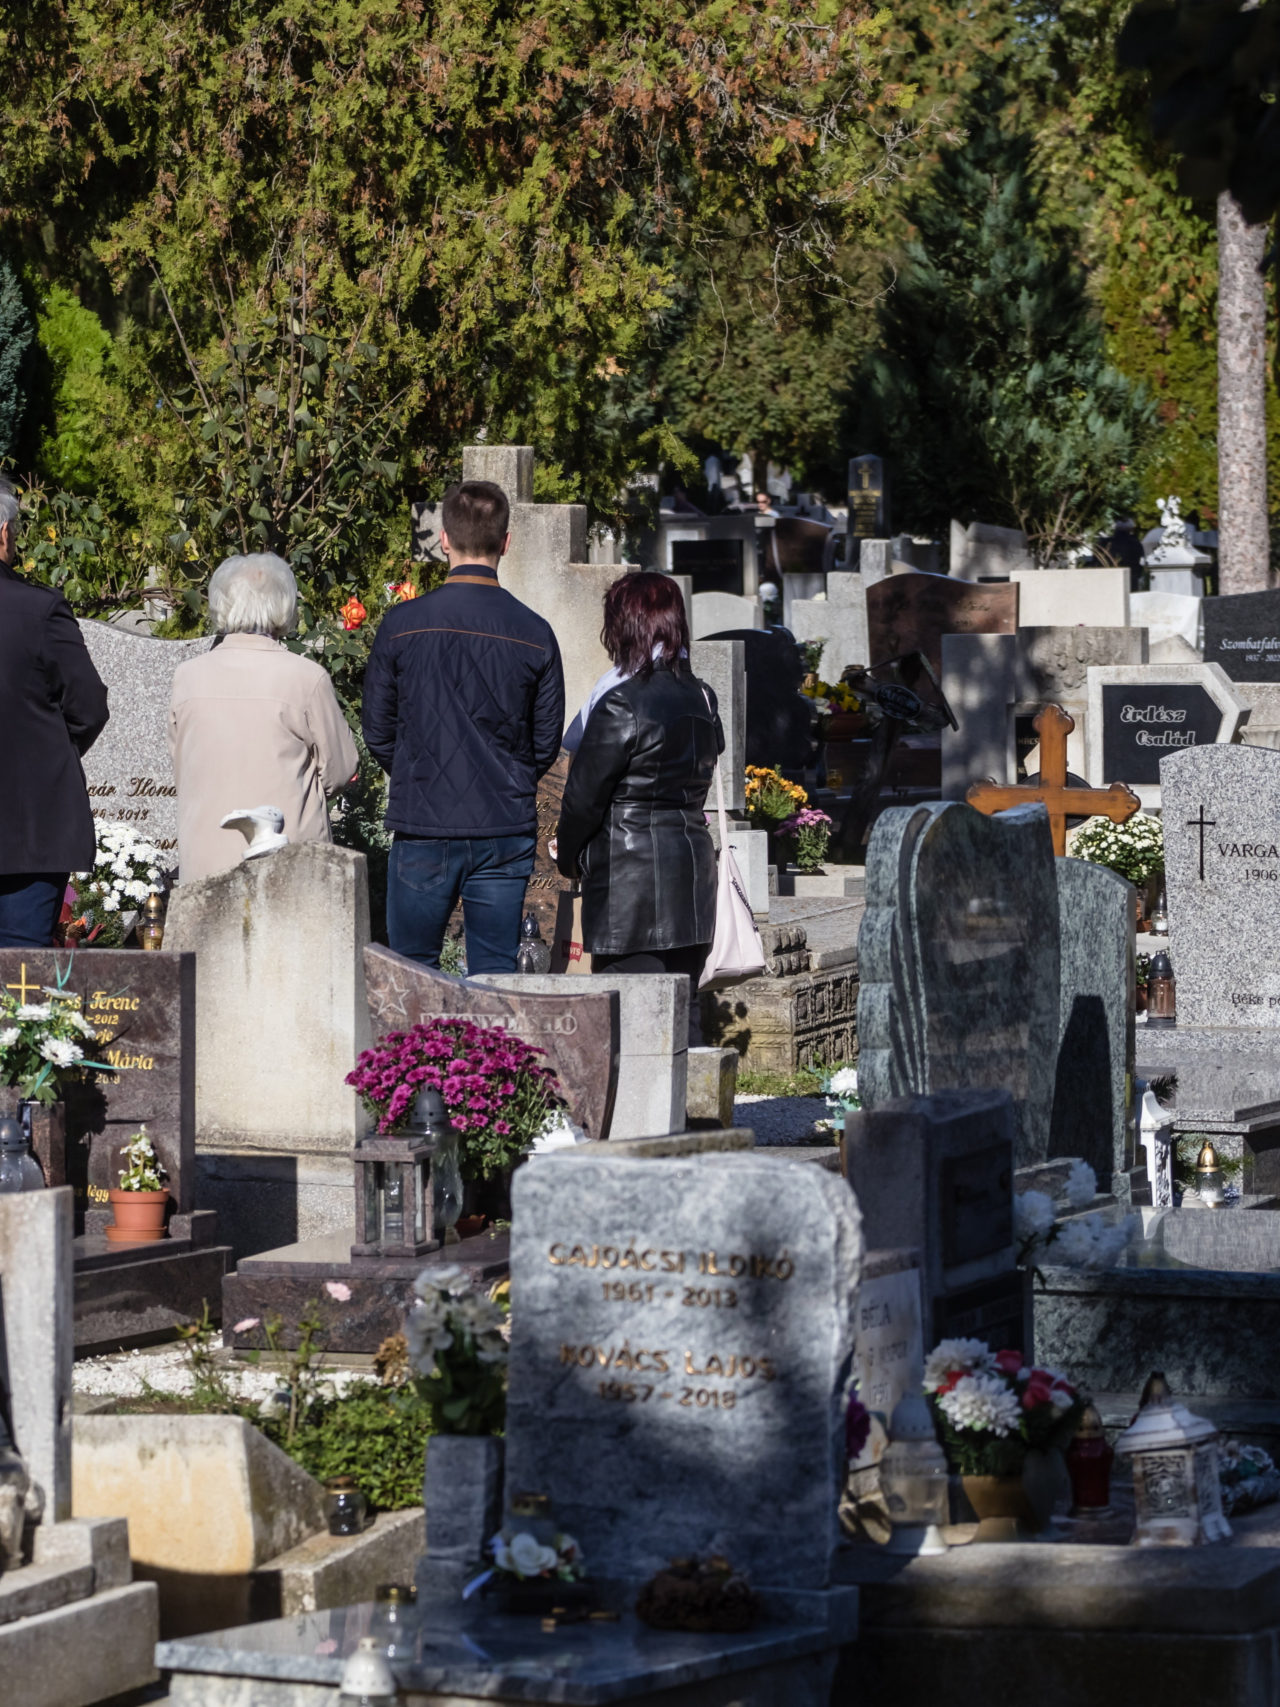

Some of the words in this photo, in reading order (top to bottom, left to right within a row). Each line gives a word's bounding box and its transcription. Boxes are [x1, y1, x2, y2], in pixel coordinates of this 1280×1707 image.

[1120, 704, 1187, 723] Erdész
[1135, 730, 1196, 746] Család
[1218, 843, 1280, 858] VARGA
[89, 991, 140, 1011] Ferenc
[106, 1050, 154, 1070] Mária
[699, 1250, 795, 1281] ILDIKÓ
[601, 1281, 655, 1303] 1961
[681, 1286, 739, 1309] 2013
[559, 1338, 670, 1373] KOVÁCS
[684, 1350, 777, 1383] LAJOS
[598, 1380, 655, 1403] 1957
[678, 1385, 738, 1410] 2018
